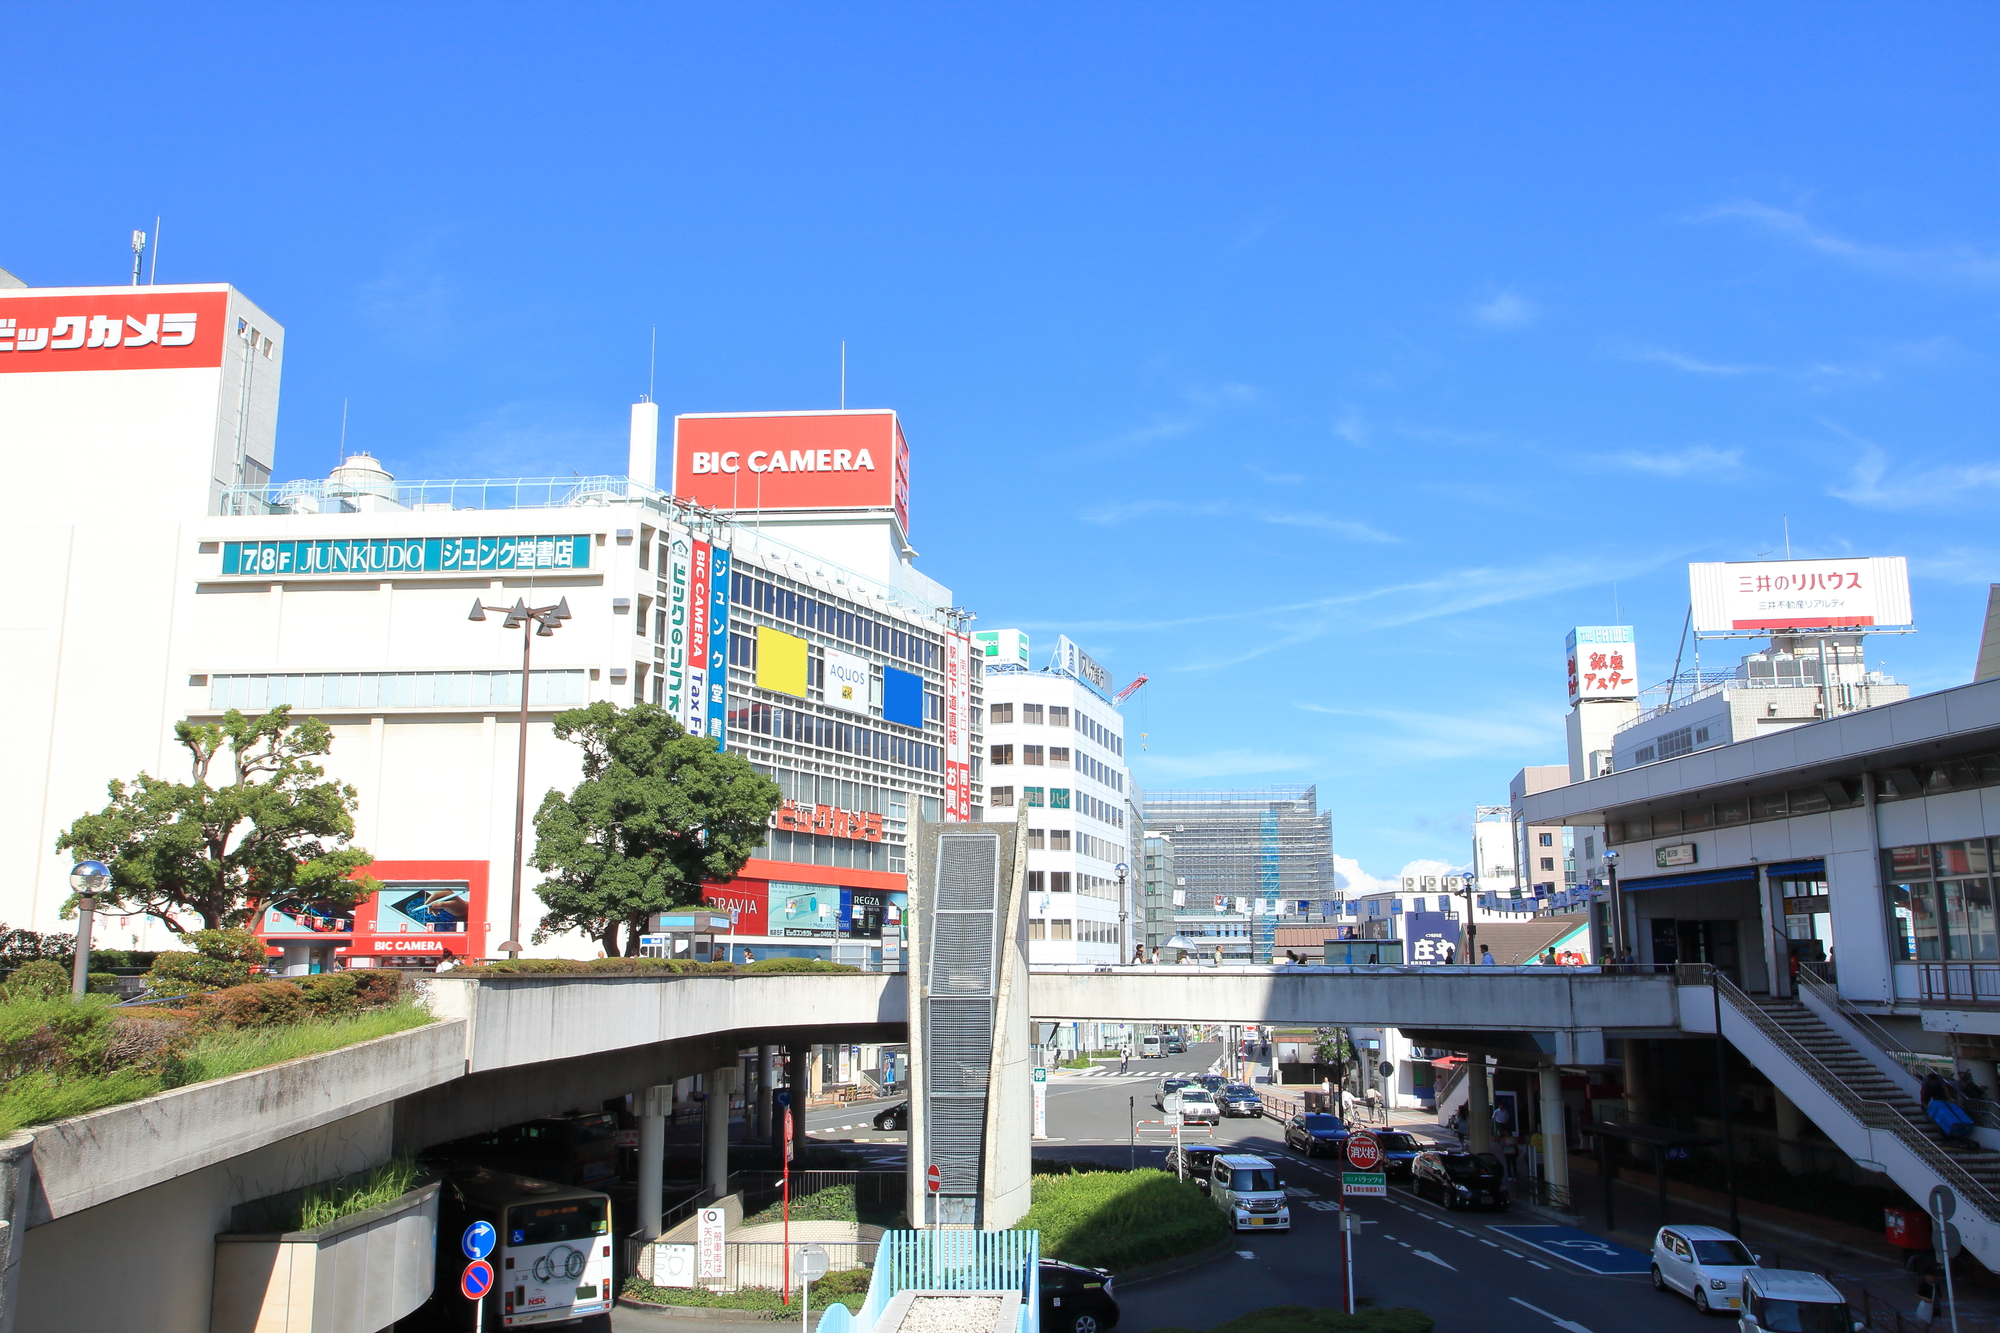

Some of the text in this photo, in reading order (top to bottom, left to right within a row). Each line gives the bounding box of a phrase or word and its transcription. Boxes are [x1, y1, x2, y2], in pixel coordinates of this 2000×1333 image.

[692, 448, 875, 474] BIC CAMERA
[300, 544, 425, 571] JUNKUDO
[442, 539, 573, 568] ジュンク堂書店
[1738, 571, 1863, 593] 三井のリハウス
[693, 549, 706, 657] BIC CAMERA
[1758, 599, 1846, 611] 三井不動産リアルティ
[1580, 631, 1594, 642] THE
[1594, 627, 1628, 643] PRIME
[1588, 650, 1625, 671] 銀座
[829, 663, 866, 685] AQUOS
[1583, 670, 1634, 692] アスター
[690, 672, 703, 712] Tax
[842, 689, 853, 700] 4K
[775, 798, 883, 842] ビックカメラ
[1657, 851, 1666, 861] JR
[853, 895, 880, 906] REGZA
[374, 940, 443, 951] BIC CAMERA
[1413, 938, 1456, 961] 庄や
[1350, 1146, 1377, 1159] 消火栓
[1353, 1175, 1383, 1184] パラッツォ
[703, 1226, 713, 1277] 矢印の方へ
[713, 1225, 723, 1274] 一般車両は
[527, 1296, 547, 1306] NSK
